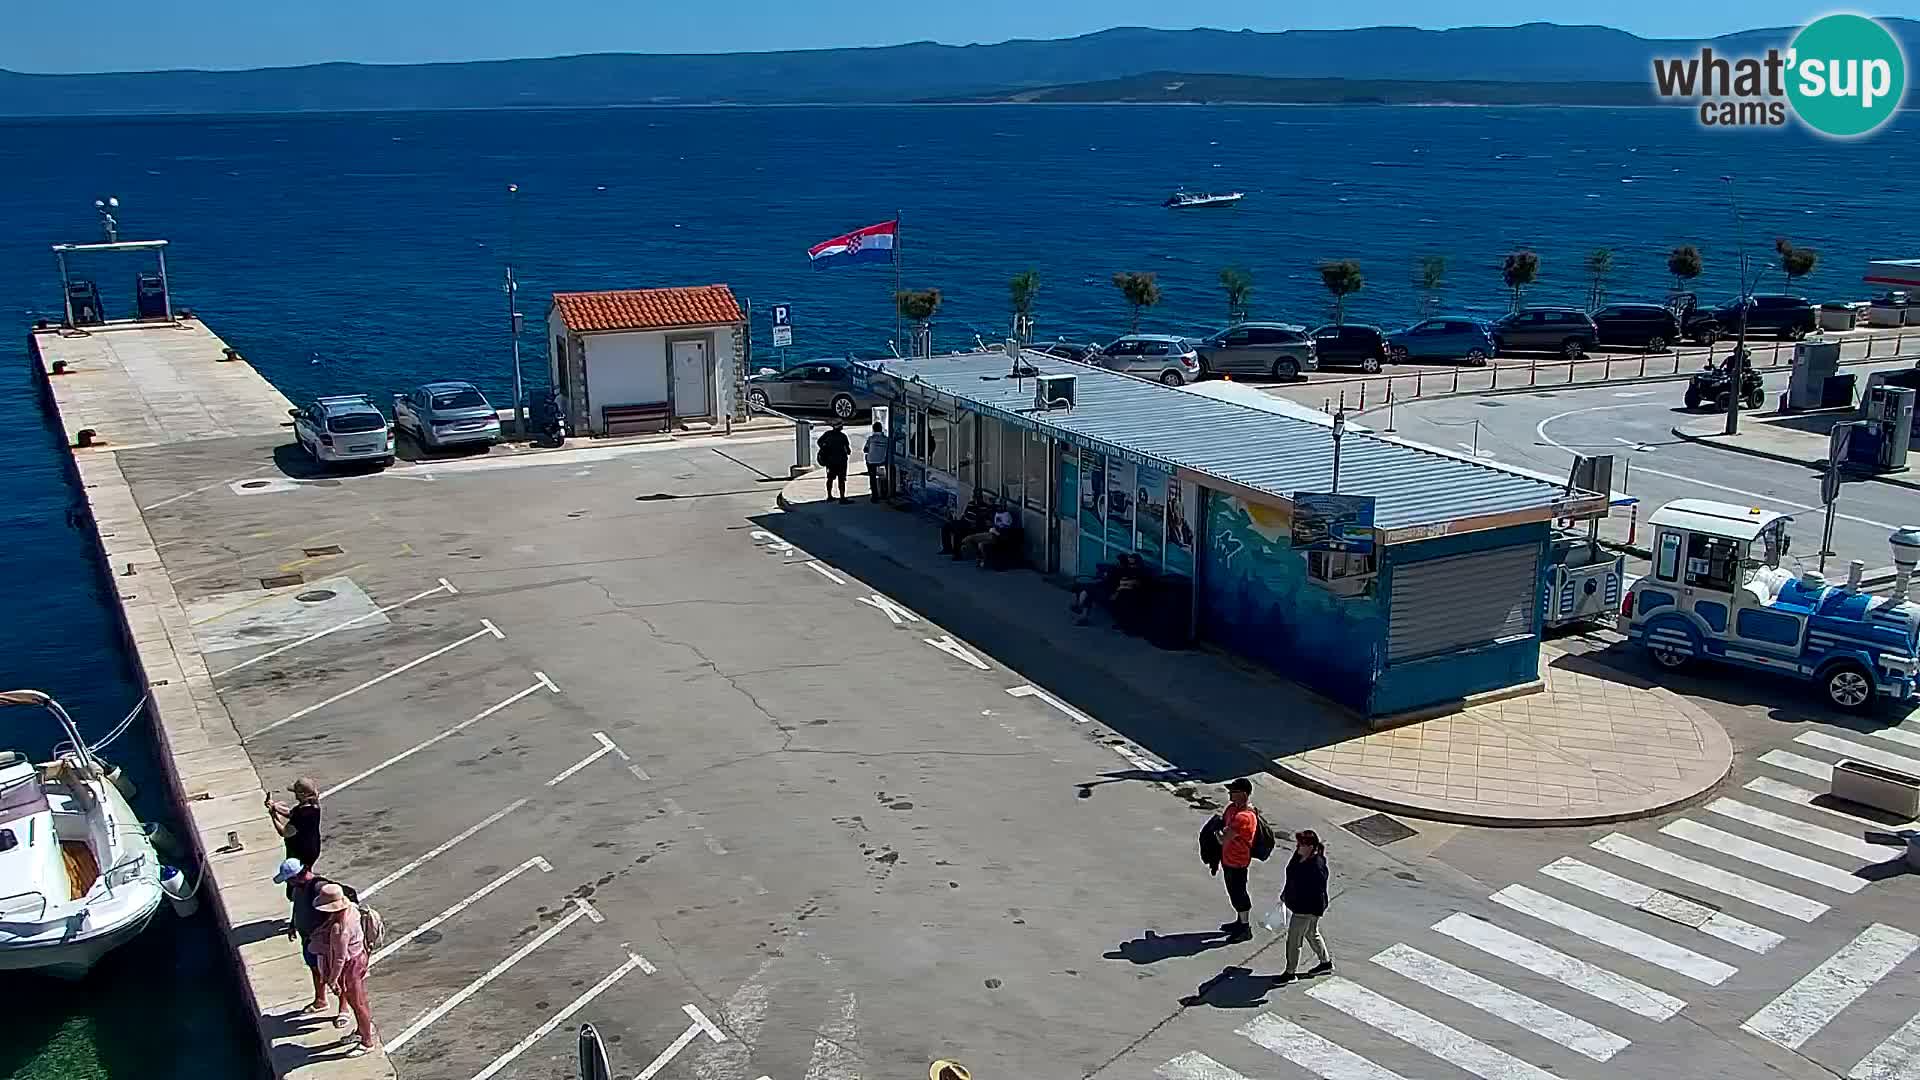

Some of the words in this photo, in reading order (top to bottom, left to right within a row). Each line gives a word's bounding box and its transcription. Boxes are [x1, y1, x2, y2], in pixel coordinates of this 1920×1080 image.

[776, 307, 787, 324] P
[1075, 435, 1090, 449] BUS
[1090, 440, 1120, 457] STATION
[1123, 452, 1146, 466] TICKET
[1147, 457, 1174, 475] OFFICE
